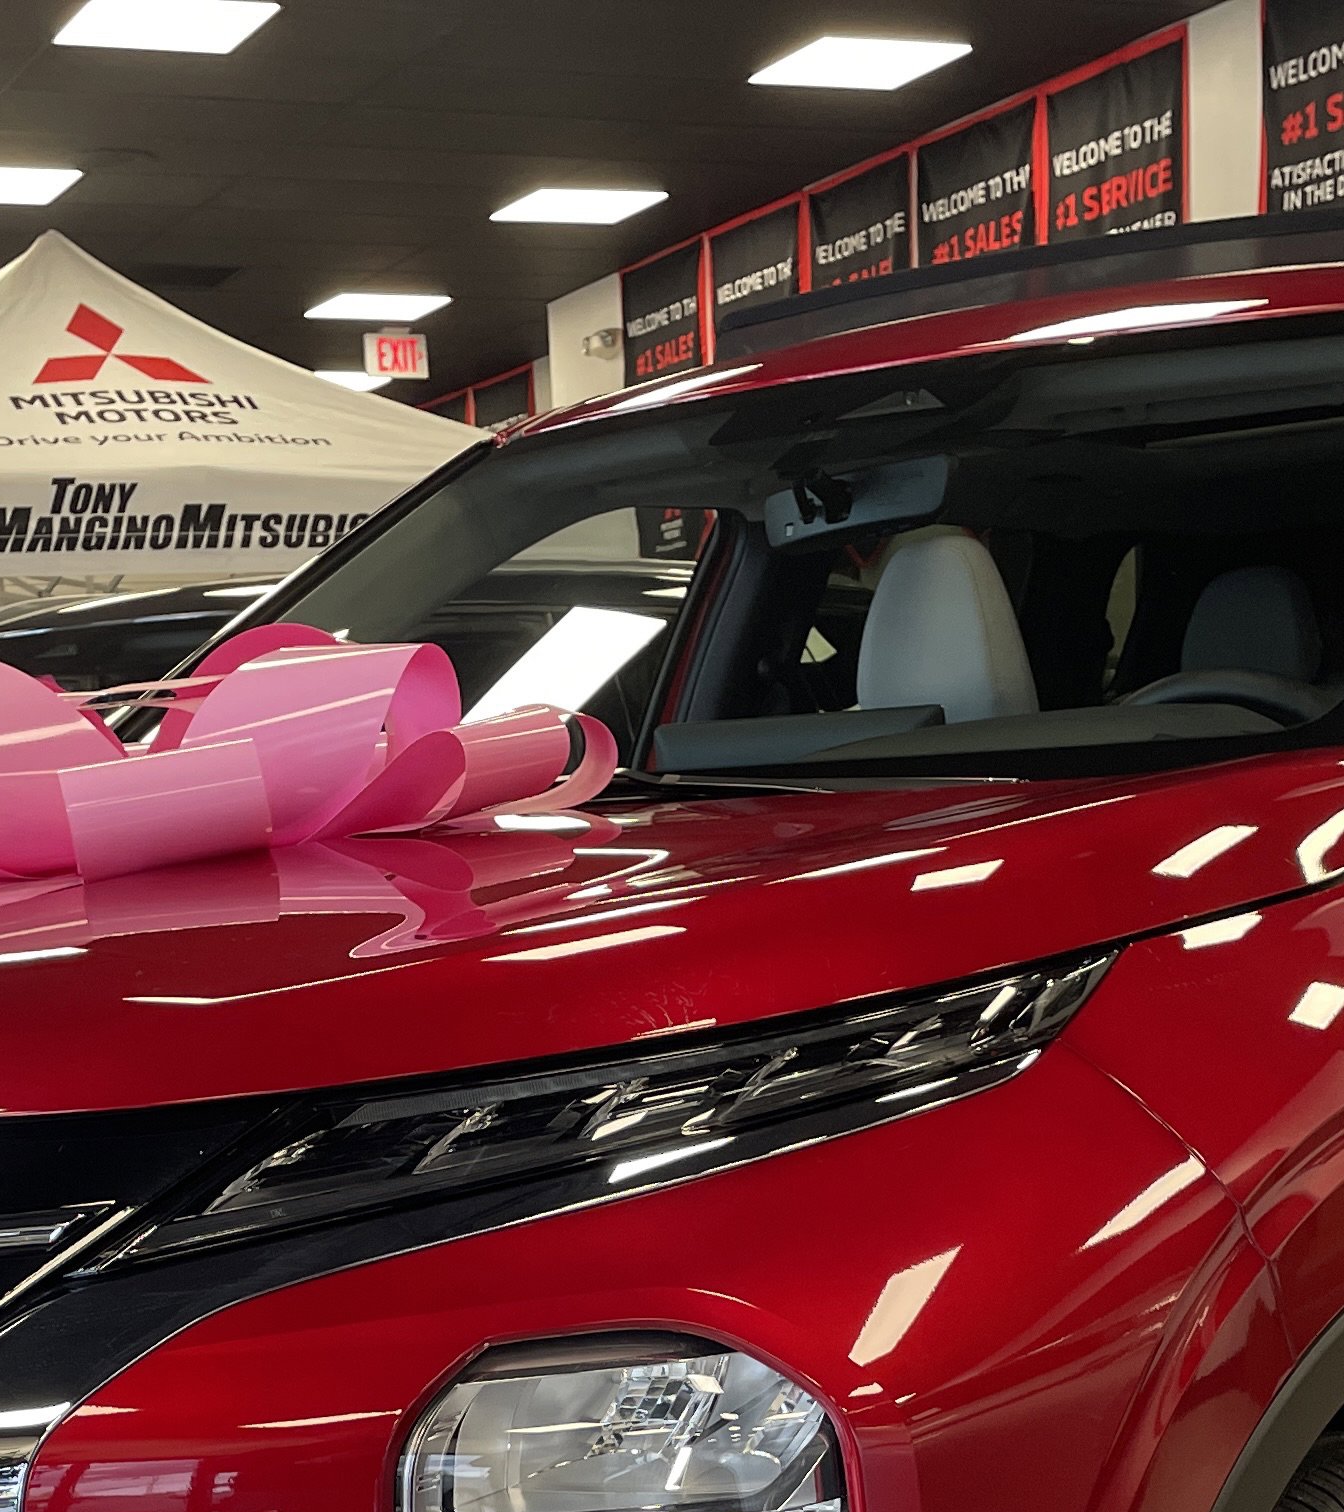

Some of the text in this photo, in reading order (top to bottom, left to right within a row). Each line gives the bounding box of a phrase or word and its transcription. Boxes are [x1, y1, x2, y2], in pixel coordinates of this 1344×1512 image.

[1122, 123, 1143, 151] TO
[1142, 109, 1173, 145] THE
[1280, 102, 1319, 146] #1
[922, 178, 987, 223] WELCOME
[1055, 193, 1080, 231] #1
[1082, 157, 1174, 222] SERVICE
[1282, 188, 1304, 212] IN
[1305, 179, 1336, 207] THE
[931, 209, 1024, 266] #1 SALES
[376, 336, 418, 374] EXIT
[8, 388, 262, 411] MITSUBISHI
[55, 407, 240, 426] MOTORS
[90, 430, 169, 447] your
[177, 429, 334, 447] Ambition
